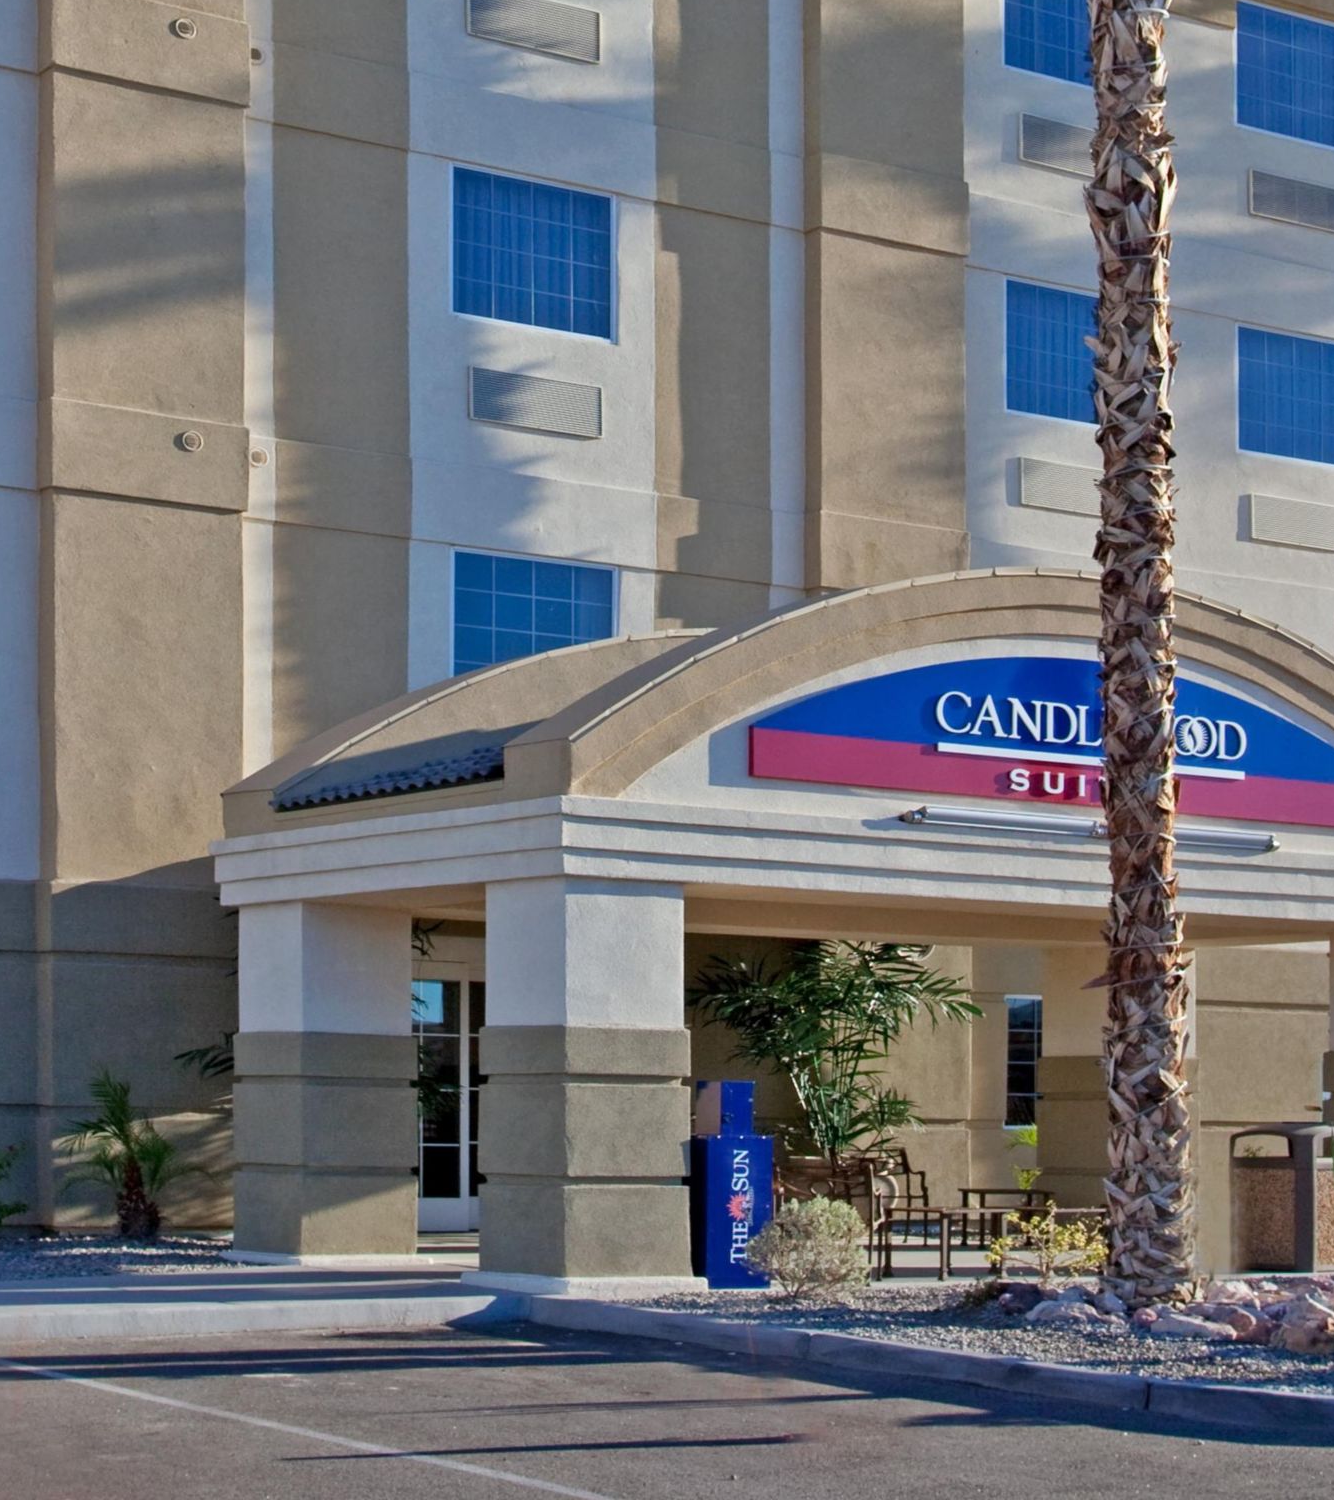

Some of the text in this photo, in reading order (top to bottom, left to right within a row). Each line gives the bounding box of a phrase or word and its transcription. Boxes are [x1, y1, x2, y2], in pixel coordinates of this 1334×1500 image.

[936, 691, 1247, 760] CANDLOOD
[730, 1149, 749, 1264] THE SUN
